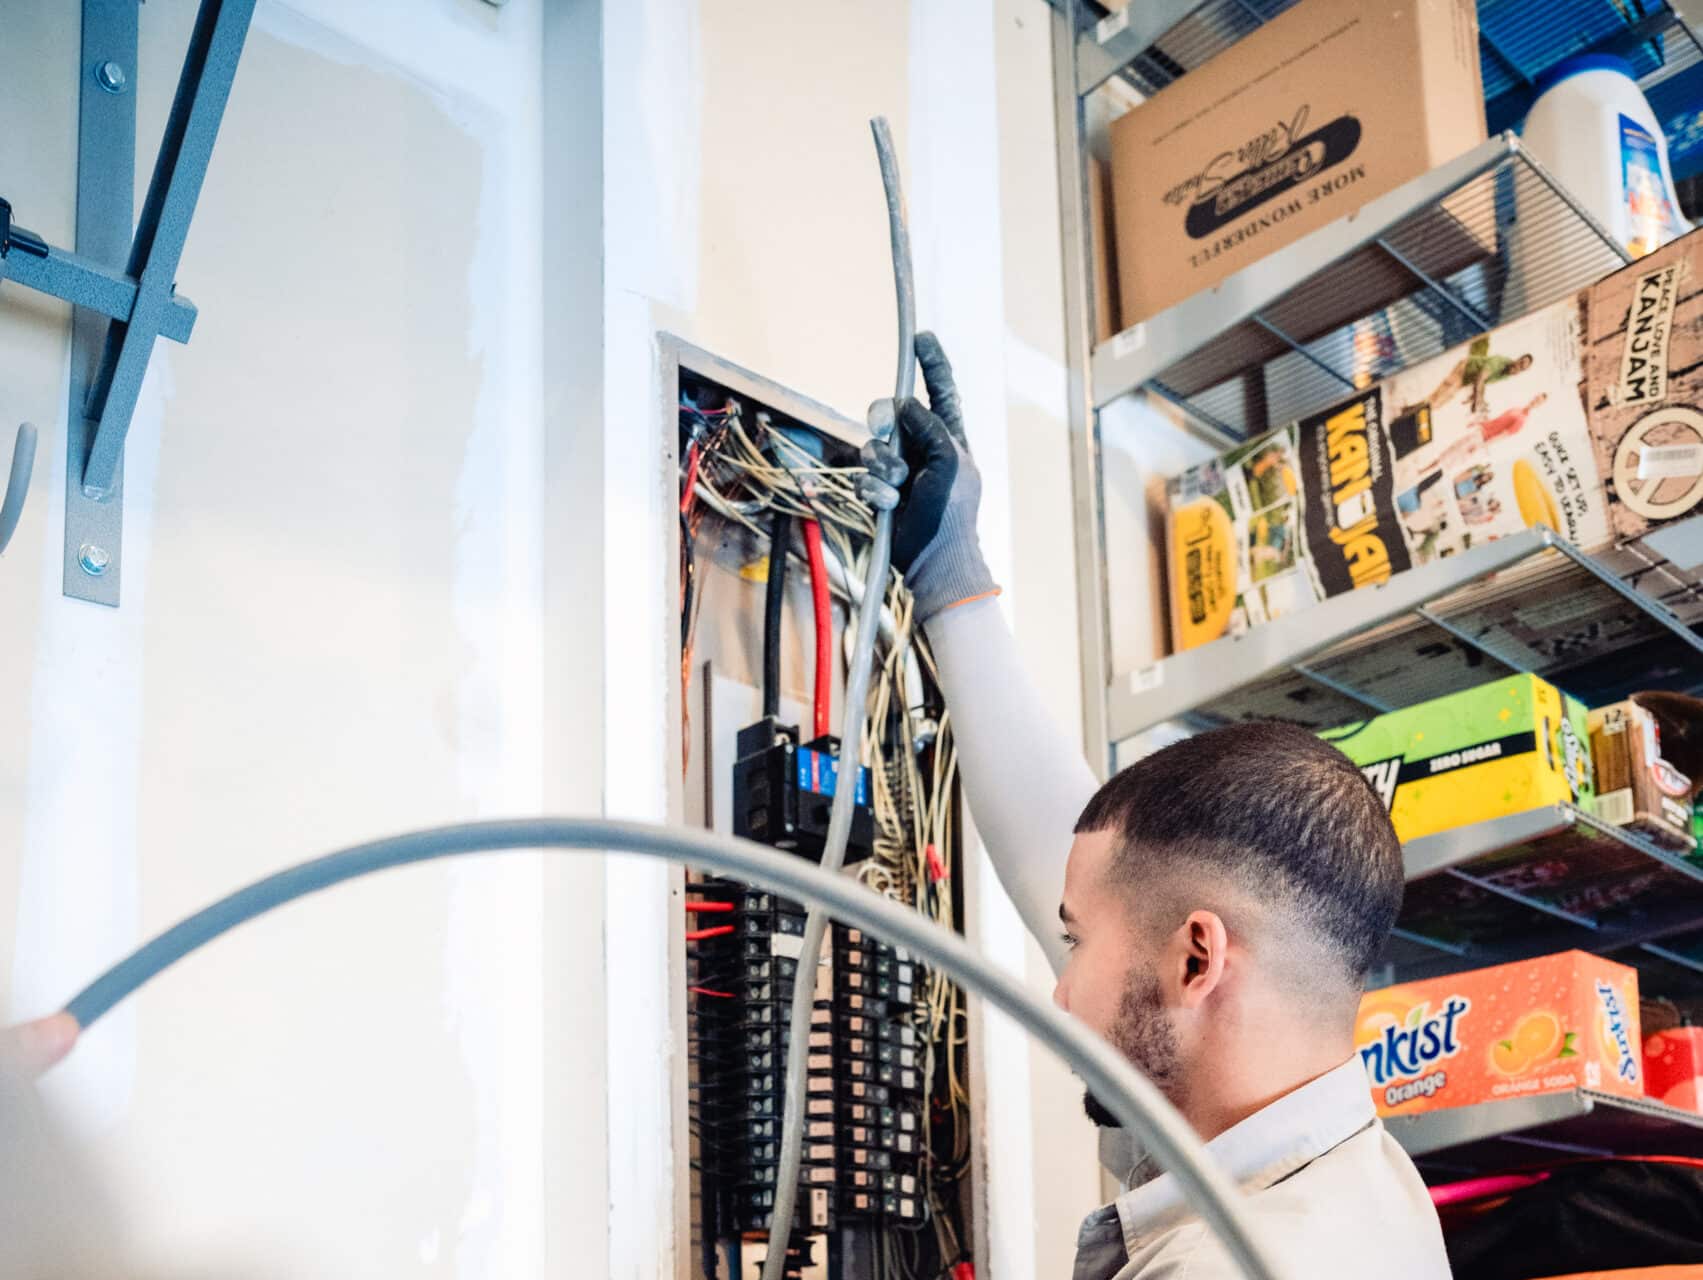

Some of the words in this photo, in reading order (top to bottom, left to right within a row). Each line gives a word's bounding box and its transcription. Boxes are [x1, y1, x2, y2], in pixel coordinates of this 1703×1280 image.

[1308, 164, 1367, 205] MORE
[1189, 199, 1303, 267] WONDERFUL
[1659, 268, 1675, 313] PEACE
[1625, 273, 1663, 402] KANJAM
[1650, 321, 1665, 359] LOVE
[1649, 364, 1660, 398] AND
[1534, 441, 1555, 475] EASY
[1554, 475, 1565, 494] TO
[1604, 709, 1622, 725] 12
[1430, 752, 1462, 773] ZERO
[1462, 741, 1502, 765] SUGAR
[1598, 982, 1637, 1083] Sunkist
[1384, 1070, 1447, 1106] Orange
[1492, 1078, 1540, 1096] ORANGE
[1543, 1073, 1577, 1089] SODA
